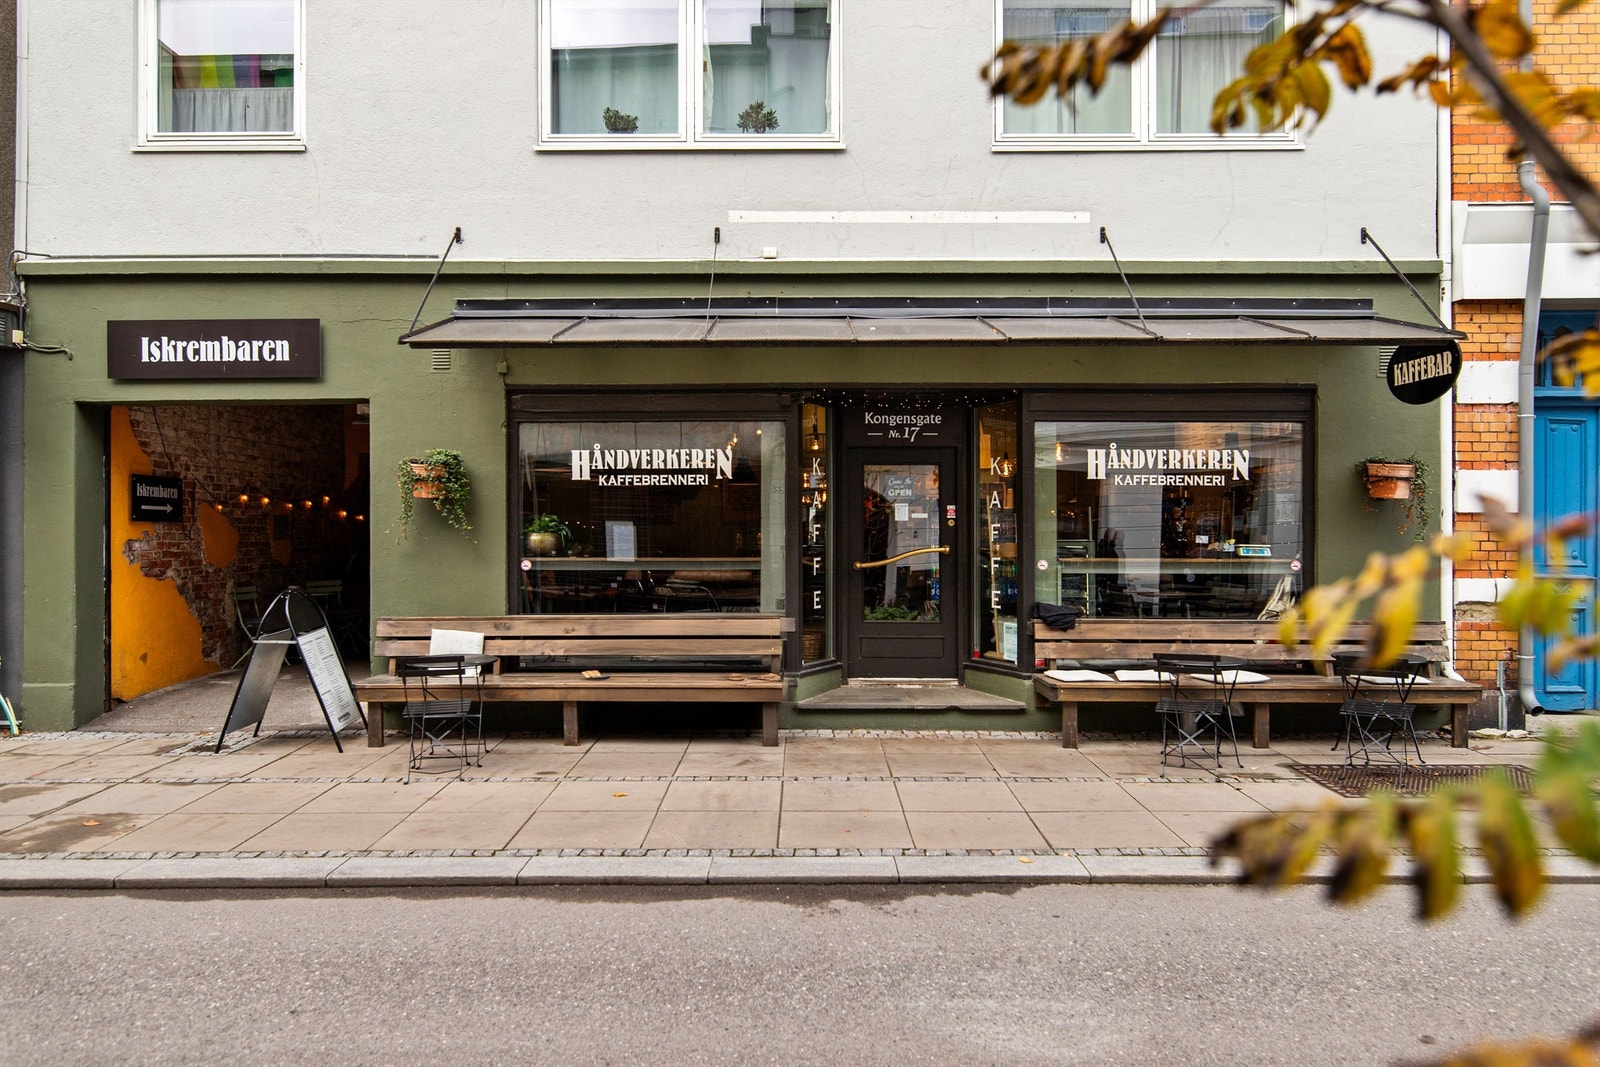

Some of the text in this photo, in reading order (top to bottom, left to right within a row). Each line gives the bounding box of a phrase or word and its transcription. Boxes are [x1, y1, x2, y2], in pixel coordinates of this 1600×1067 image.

[140, 336, 291, 363] Iskrembaren
[1393, 350, 1453, 387] KAFFEBAR
[864, 411, 942, 426] Kongensgate
[888, 426, 921, 443] Nr. 17
[570, 442, 733, 481] HÅNDVERKEREN
[1086, 442, 1250, 481] HÅNDVERKEREN
[136, 482, 179, 499] Iskrembaren
[598, 474, 709, 487] KAFFEBRENNERI
[1114, 474, 1226, 487] KAFFEBRENNERI
[888, 488, 912, 497] OPEN
[812, 457, 822, 610] KAFFE
[990, 456, 1002, 610] KAFFE
